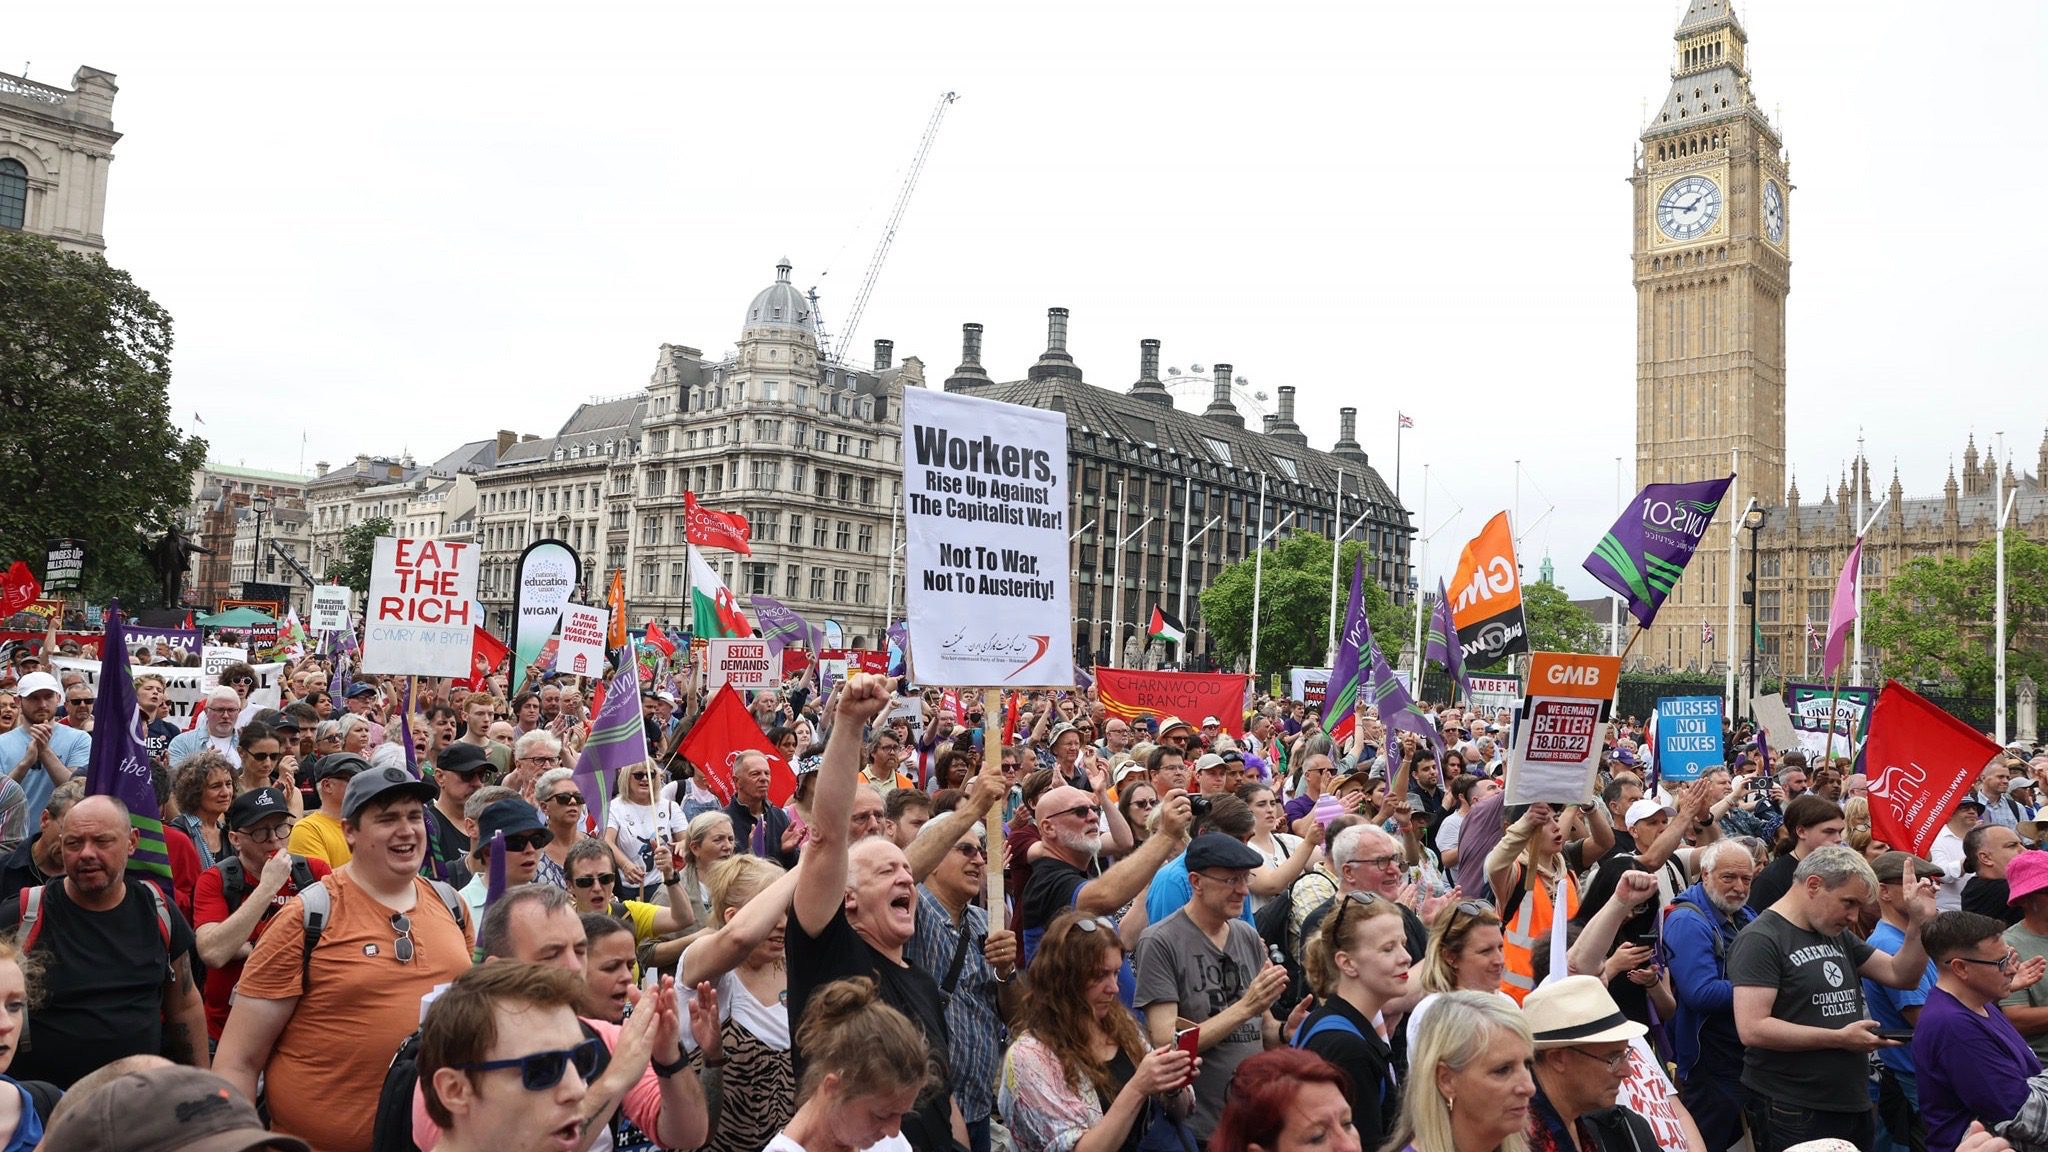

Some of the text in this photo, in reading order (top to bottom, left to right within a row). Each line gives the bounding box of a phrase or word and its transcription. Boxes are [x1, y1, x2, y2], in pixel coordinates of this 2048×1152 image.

[913, 425, 1057, 486] Workers,
[925, 471, 1049, 505] Rise Up Against
[910, 493, 1062, 530] The Capitalist War!
[48, 549, 84, 561] WAGES UP
[396, 539, 467, 569] EAT
[940, 543, 1040, 577] Not To War,
[394, 569, 459, 596] THE
[524, 576, 568, 587] education
[924, 570, 1054, 602] Not To Austerity!
[379, 597, 469, 625] RICH
[523, 607, 558, 616] WIGAN
[580, 613, 598, 622] REAL
[758, 606, 791, 618] UNISON
[565, 626, 603, 639] WAGE FOR
[572, 620, 597, 630] LIVING
[373, 628, 469, 645] CYMRY AM BYTH
[564, 634, 603, 646] EVERYONE
[729, 646, 763, 658] STOKE
[720, 660, 770, 671] DEMANDS
[726, 672, 763, 683] BETTER
[1547, 664, 1600, 686] GMB
[1117, 677, 1221, 695] CHARNWOOD
[1305, 686, 1326, 694] MAKE
[1471, 680, 1516, 692] AMBETH
[1138, 693, 1198, 709] BRANCH
[1663, 701, 1717, 716] NURSES
[1547, 705, 1596, 716] WE DEMAND
[1807, 707, 1854, 719] UNION
[1535, 715, 1593, 734] BETTER
[1677, 720, 1705, 733] NOT
[1536, 735, 1585, 750] 18.06.22
[1668, 737, 1715, 751] NUKES
[120, 756, 147, 777] the
[1789, 944, 1846, 967] GREENDA
[1822, 1001, 1857, 1017] COLLEGE
